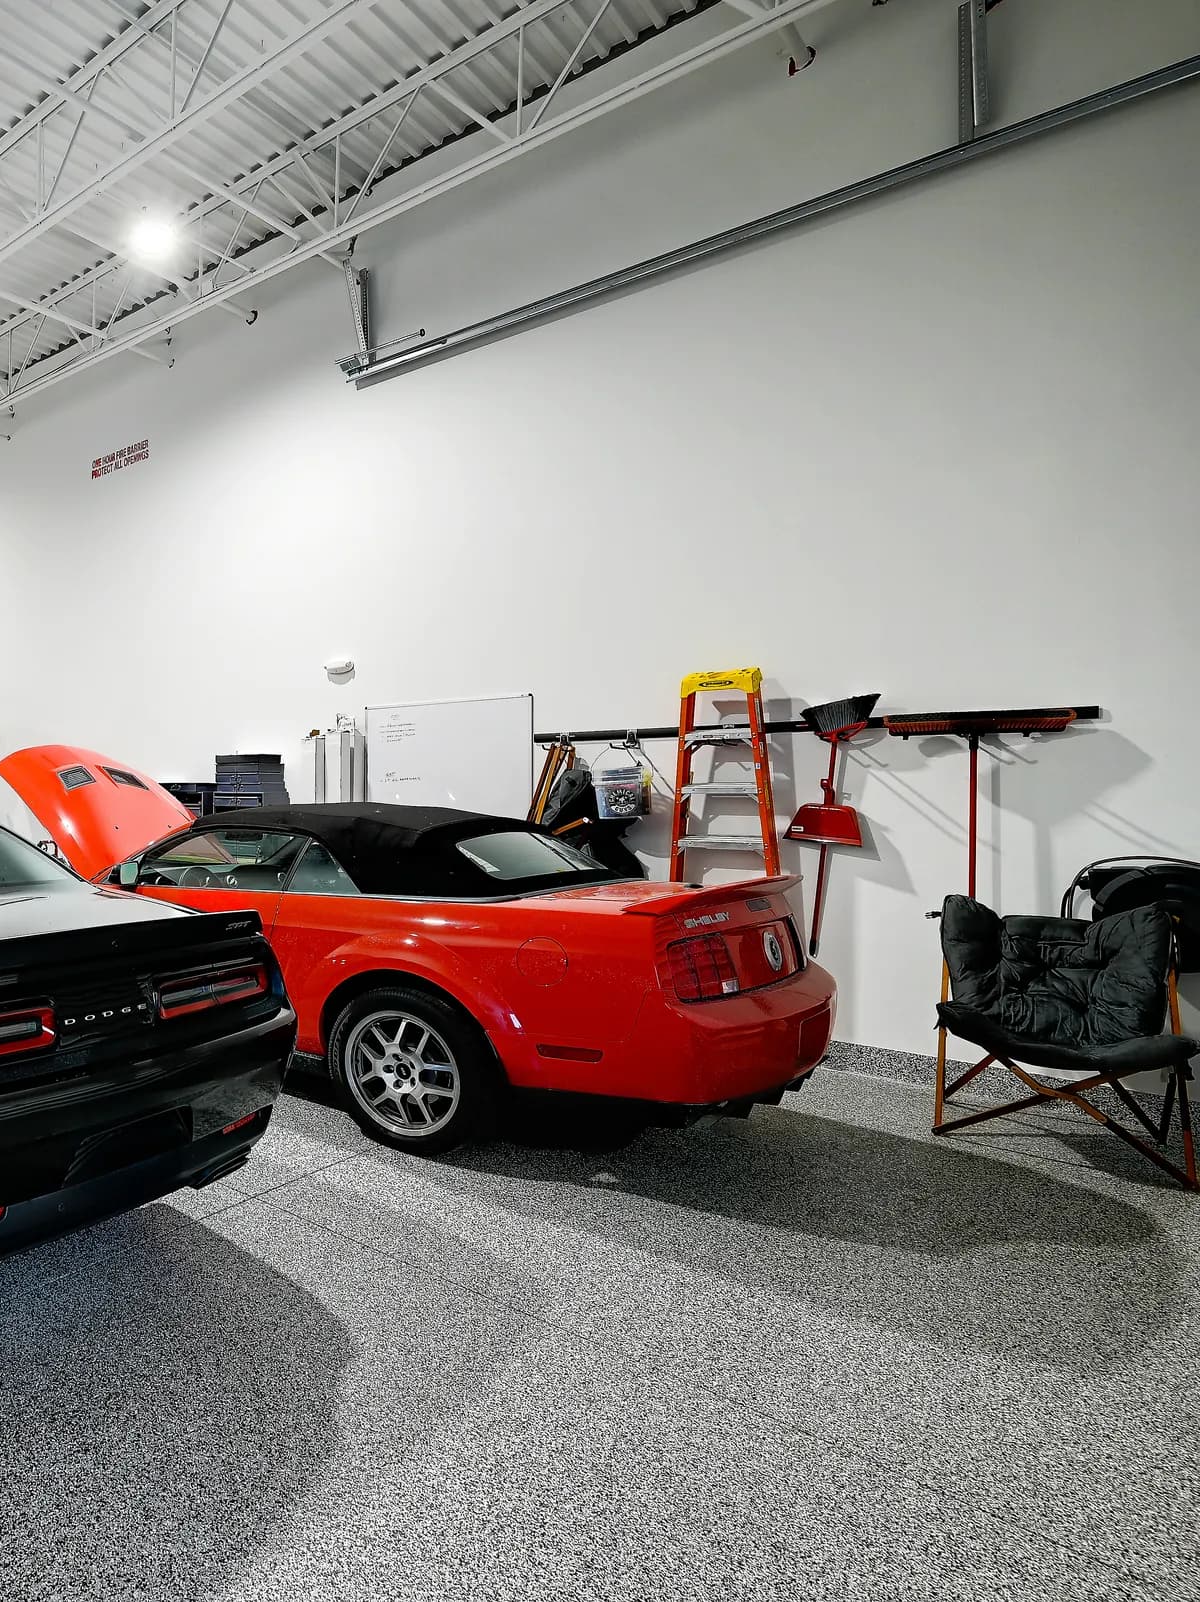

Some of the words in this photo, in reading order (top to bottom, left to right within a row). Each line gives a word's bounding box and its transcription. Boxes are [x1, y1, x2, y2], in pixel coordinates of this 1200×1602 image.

[91, 463, 113, 480] PROTECT
[123, 449, 149, 467] OPENINGS
[102, 453, 116, 466] HOUR
[116, 447, 127, 460] FIRE
[127, 439, 149, 456] BARRIER
[683, 911, 730, 929] SHELBY
[63, 1002, 148, 1026] DODGE
